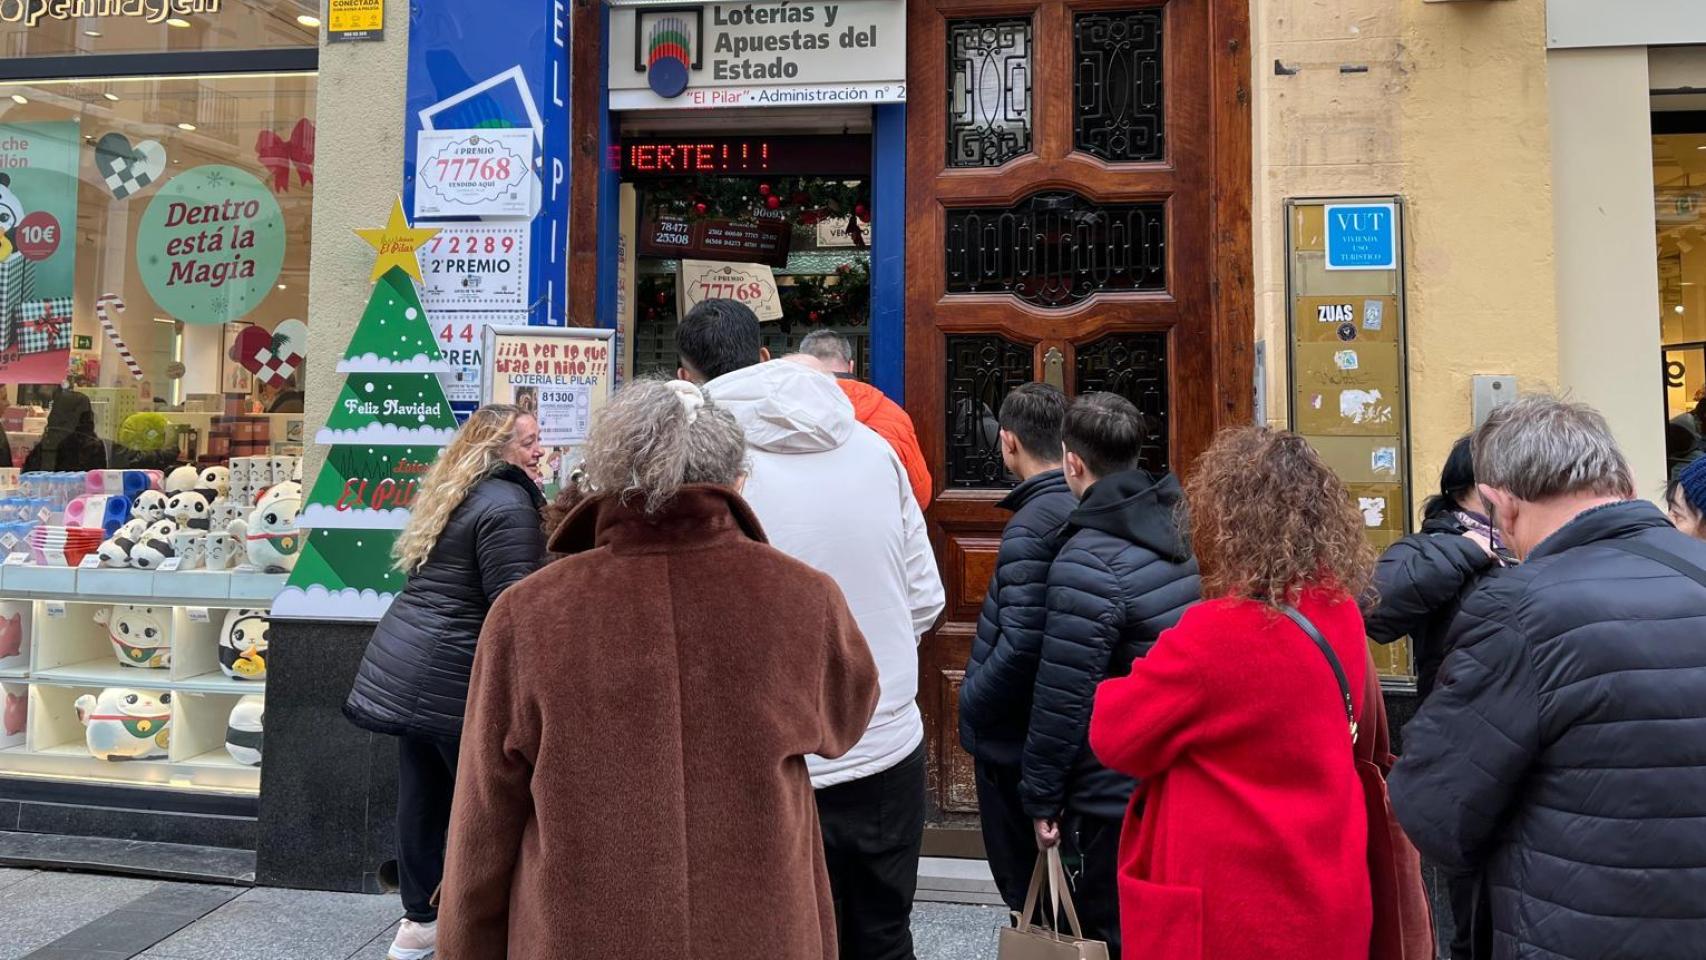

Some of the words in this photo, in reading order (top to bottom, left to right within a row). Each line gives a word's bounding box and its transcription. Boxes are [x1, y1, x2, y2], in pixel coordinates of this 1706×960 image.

[713, 1, 815, 26] Loterías
[825, 4, 839, 28] y
[714, 30, 830, 58] Apuestas
[839, 25, 877, 48] del
[713, 56, 799, 81] Estado
[758, 86, 869, 104] Administración
[896, 85, 906, 99] 2
[460, 147, 495, 155] PREMIO
[436, 157, 511, 182] 77768
[164, 199, 260, 228] Dentro
[1336, 212, 1384, 232] VUT
[21, 225, 55, 244] 10€
[166, 226, 224, 257] está
[230, 224, 255, 250] la
[656, 233, 689, 245] 25508
[830, 228, 870, 237] VENO
[1342, 235, 1379, 243] VIVIENDA
[430, 236, 514, 254] 72289
[166, 253, 256, 288] Magia
[446, 259, 511, 273] PREMIO
[700, 282, 762, 301] 77768
[1317, 304, 1353, 322] ZUAS
[440, 323, 483, 343] 44
[533, 343, 559, 358] ver
[584, 346, 607, 362] que
[495, 359, 530, 374] trae
[508, 374, 553, 385] LOTERIA
[555, 376, 568, 385] EL
[570, 376, 598, 386] PILAR
[541, 391, 575, 403] 81300
[344, 398, 380, 415] Feliz
[382, 398, 441, 416] Navidad
